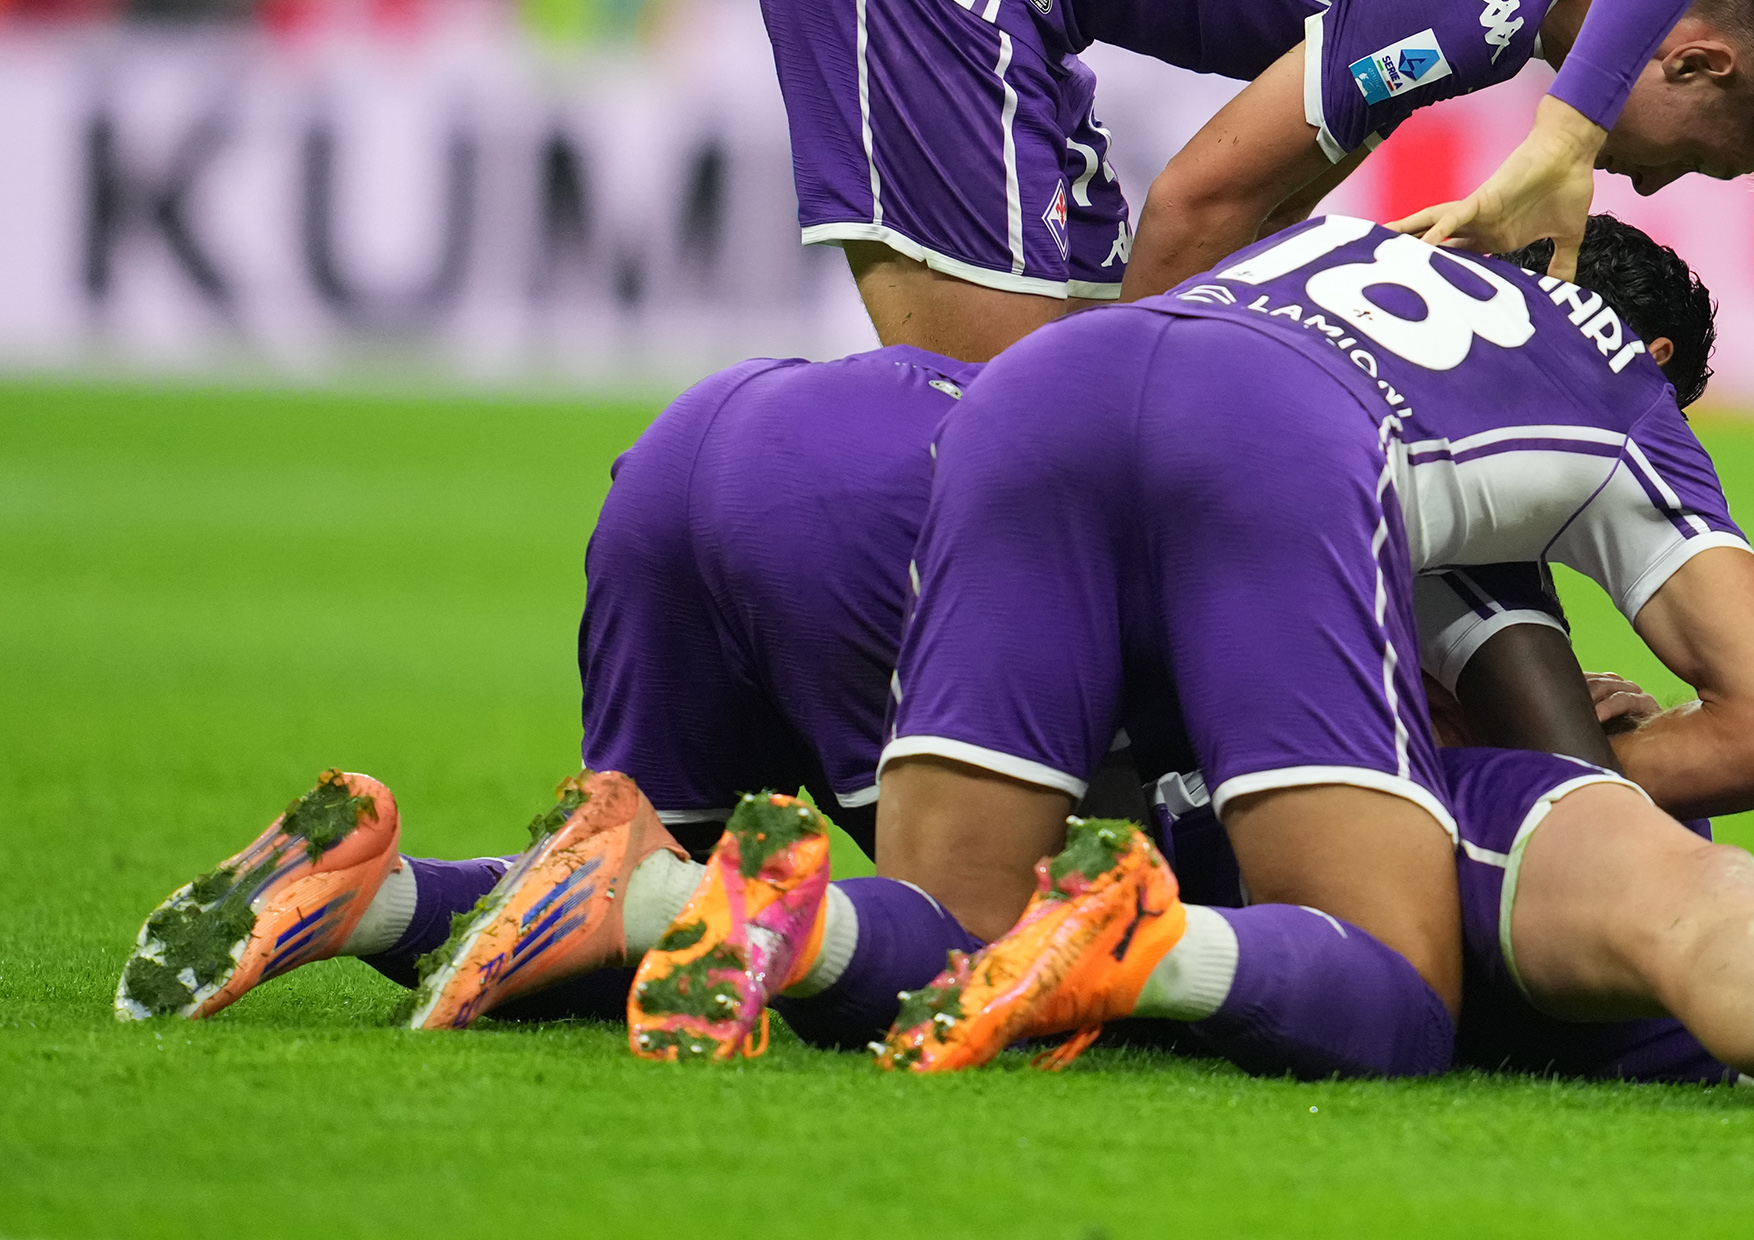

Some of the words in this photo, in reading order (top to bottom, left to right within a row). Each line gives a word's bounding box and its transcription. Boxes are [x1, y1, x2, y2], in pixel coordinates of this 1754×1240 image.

[1381, 55, 1401, 83] SERIE
[1393, 81, 1404, 90] A
[1215, 214, 1537, 371] 18
